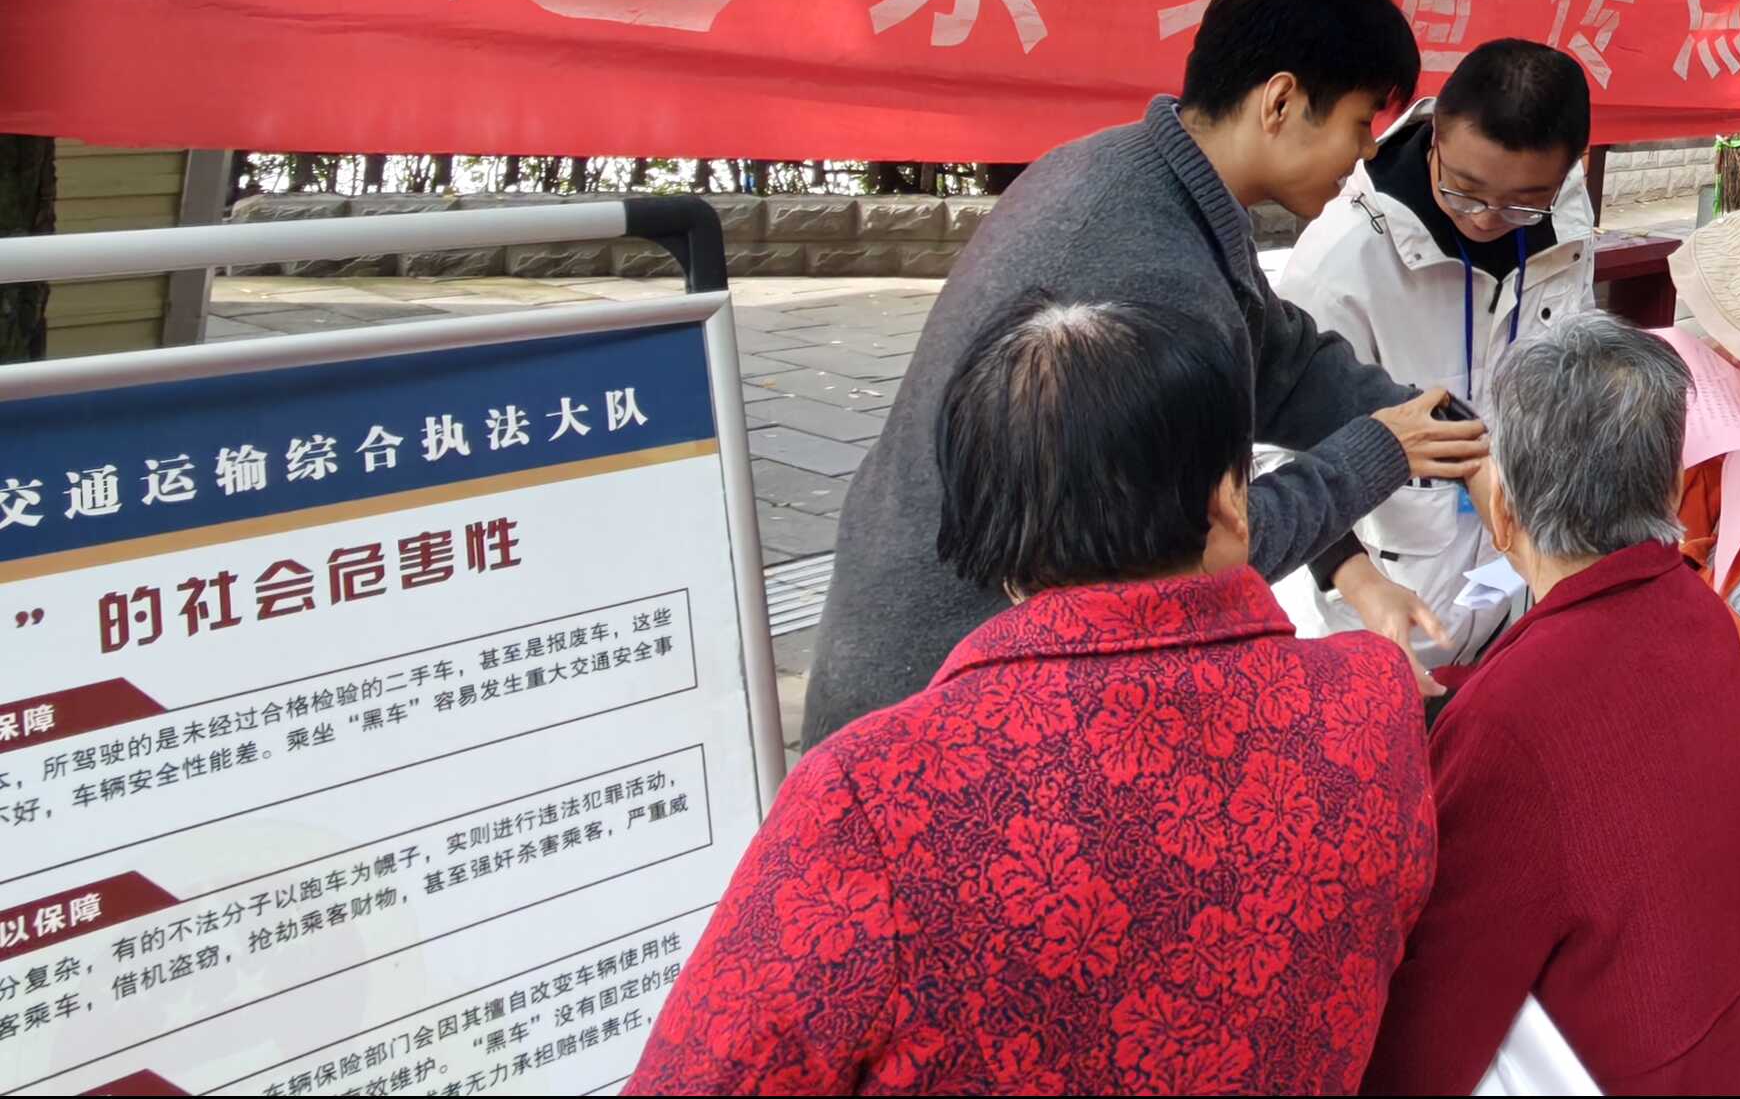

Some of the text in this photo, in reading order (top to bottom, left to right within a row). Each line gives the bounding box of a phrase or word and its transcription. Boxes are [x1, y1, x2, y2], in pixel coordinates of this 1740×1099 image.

[0, 388, 648, 530] 交通运输综合执法大队
[0, 893, 102, 948] 以保障
